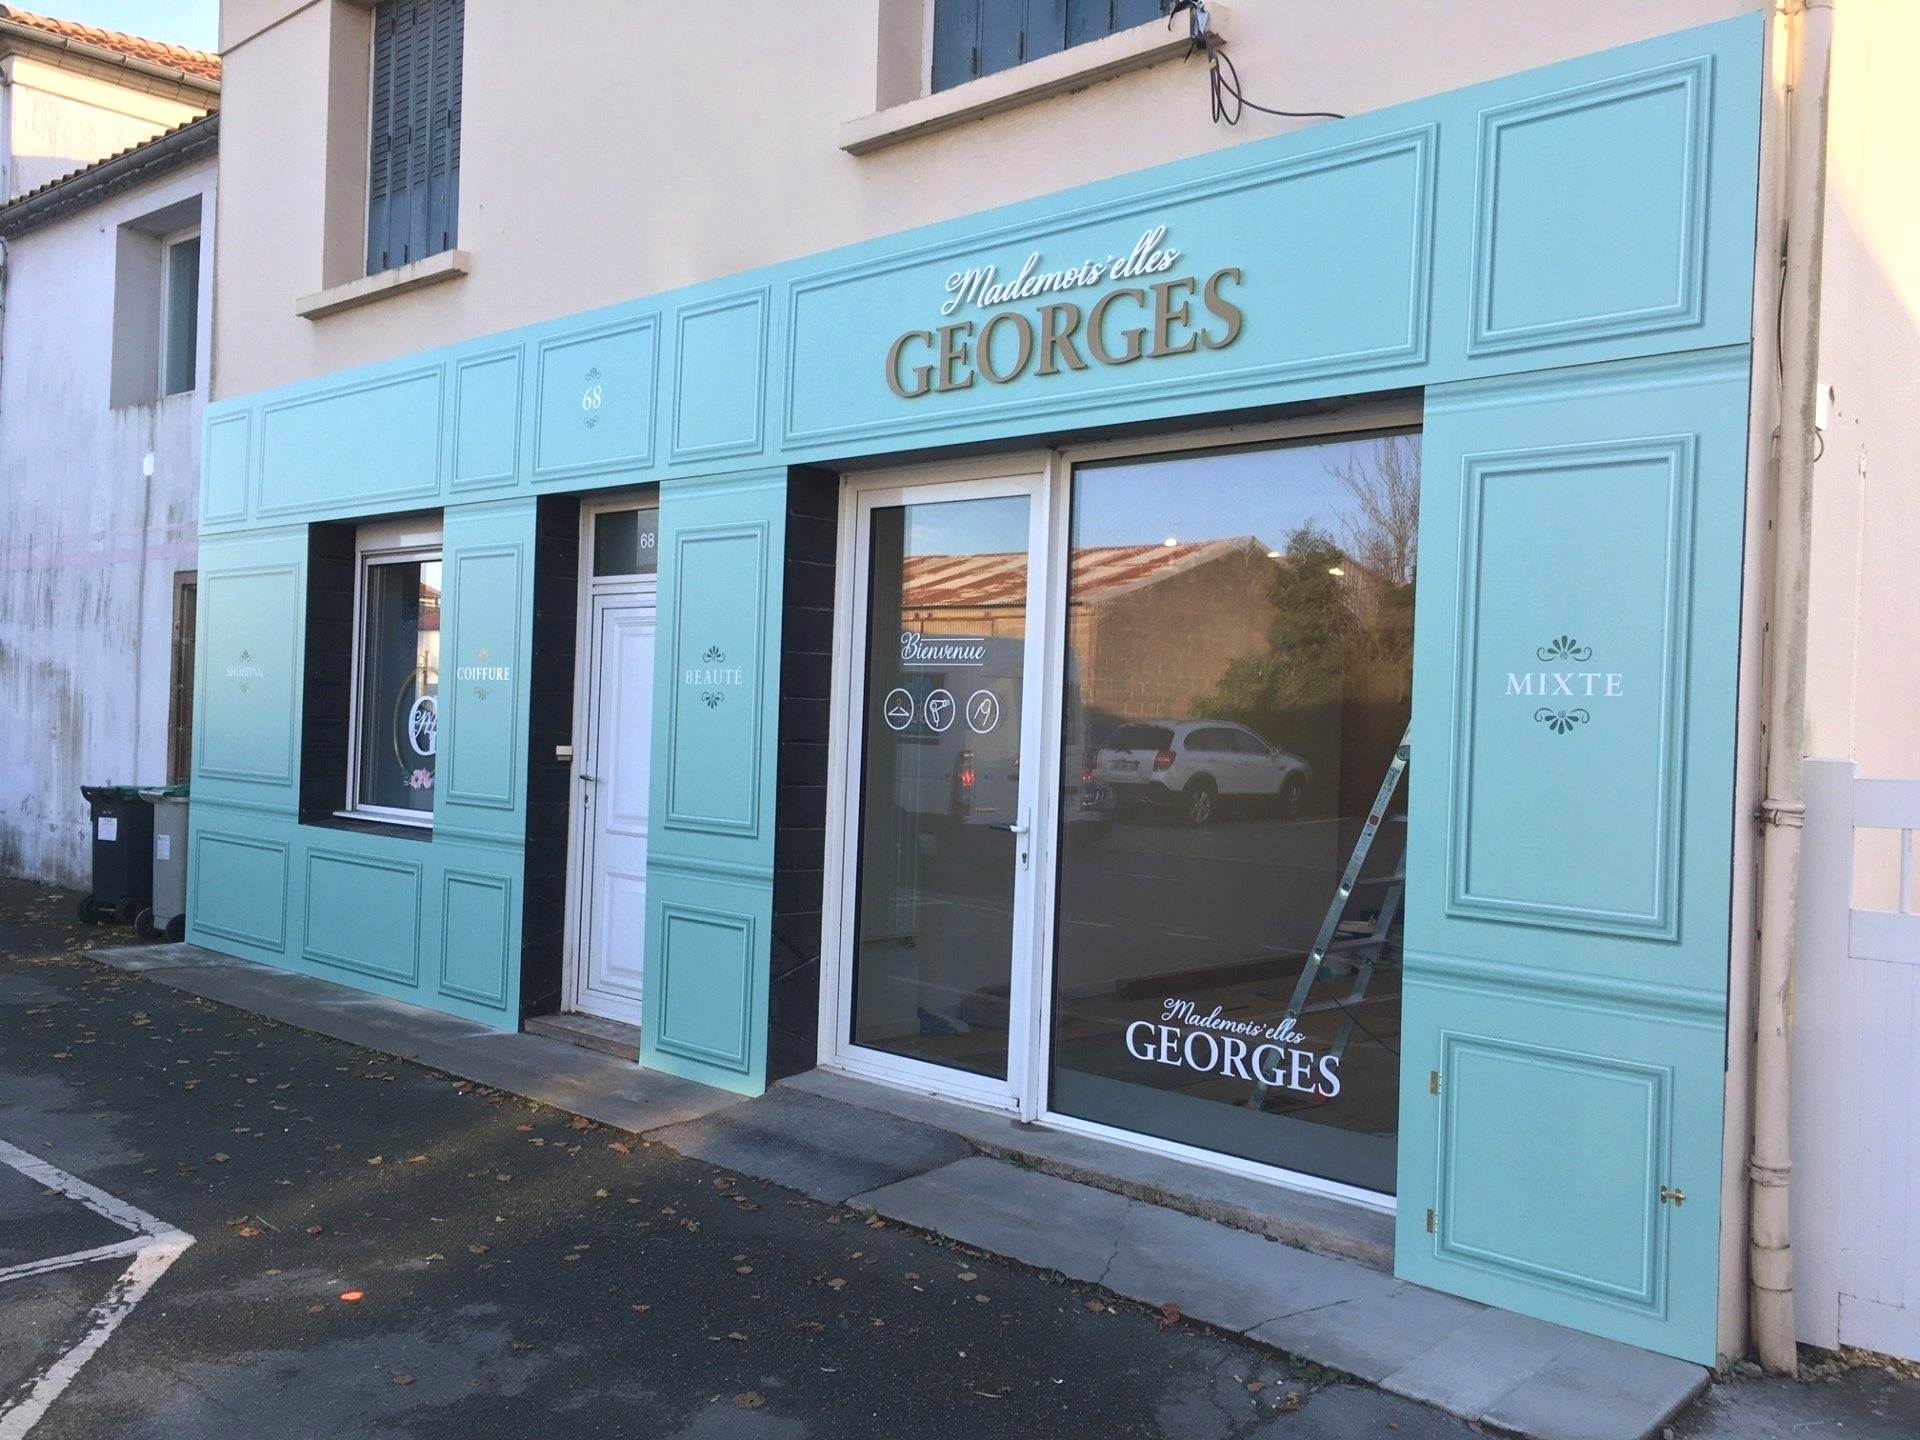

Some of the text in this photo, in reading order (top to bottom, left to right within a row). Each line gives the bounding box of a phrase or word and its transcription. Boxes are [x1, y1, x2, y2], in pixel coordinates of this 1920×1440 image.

[941, 224, 1181, 315] Mademois'elles
[885, 267, 1242, 398] GEORGES
[582, 385, 602, 411] 68
[640, 532, 655, 549] 68
[901, 632, 986, 660] Bienvenue
[226, 666, 264, 677] SHOPPING
[457, 666, 511, 681] COIFFURE
[685, 665, 743, 685] BEAUTÉ
[1504, 672, 1624, 697] MIXTE
[1161, 997, 1306, 1045] Mademois'elles
[1126, 1020, 1341, 1098] GEORGES
